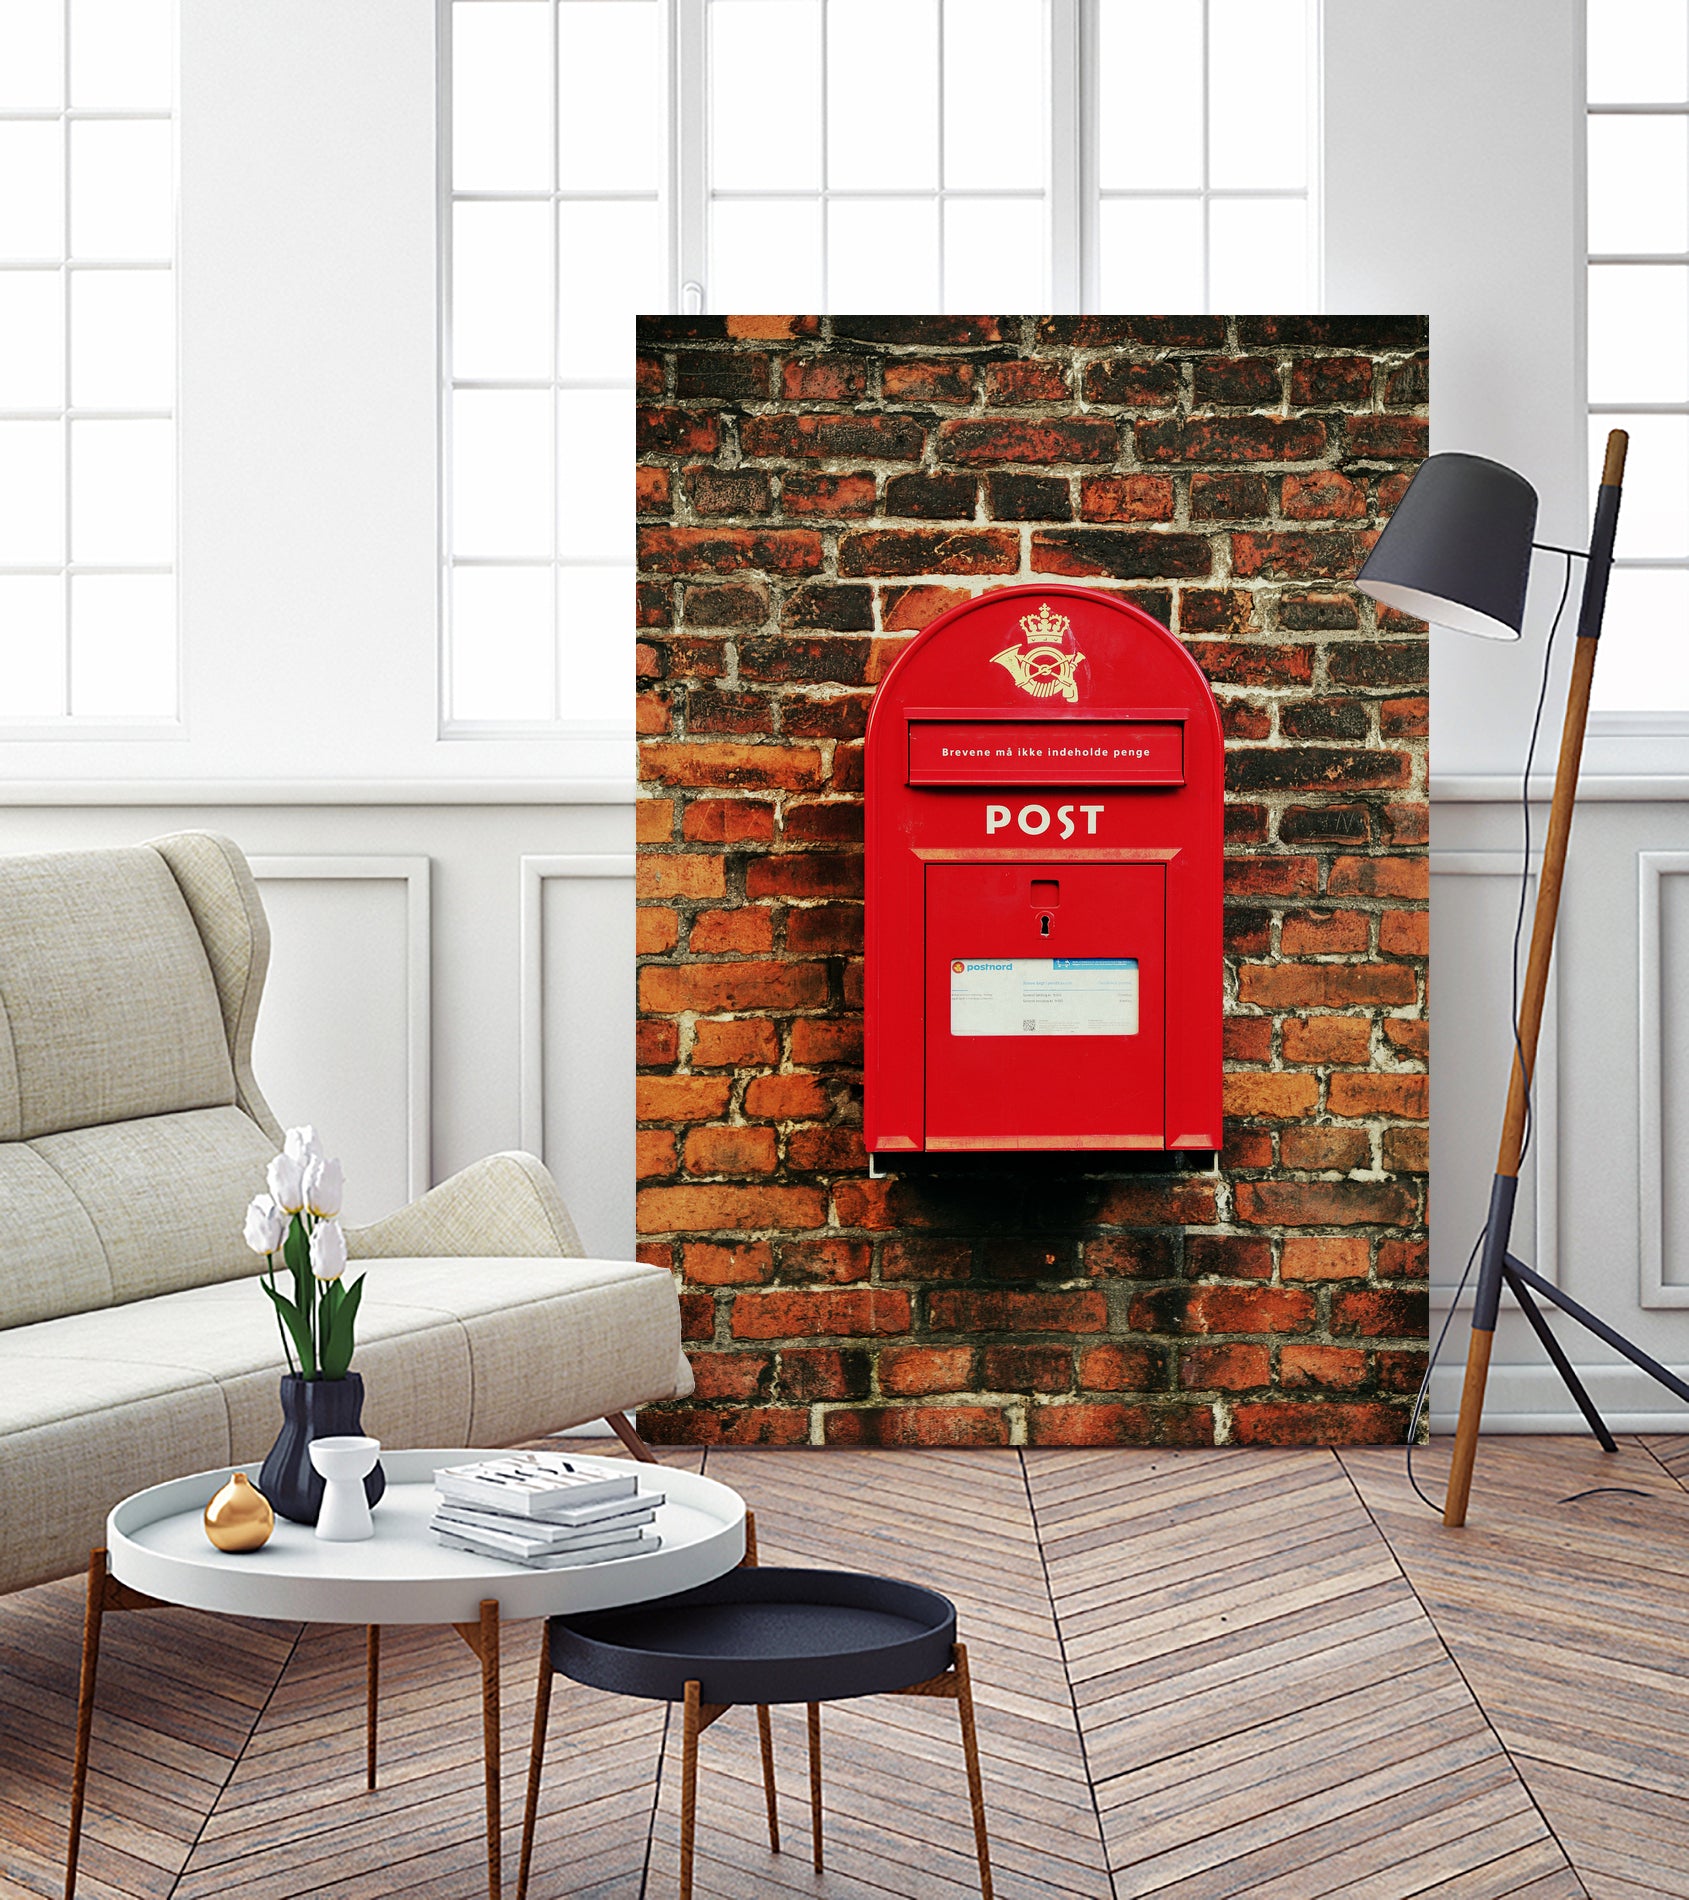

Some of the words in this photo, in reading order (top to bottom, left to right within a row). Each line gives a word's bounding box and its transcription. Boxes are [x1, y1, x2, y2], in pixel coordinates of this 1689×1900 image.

[942, 747, 991, 757] Brevene
[995, 747, 1013, 757] må
[1017, 747, 1043, 757] ikke
[1047, 747, 1109, 757] indeholde
[1113, 749, 1150, 759] penge
[986, 804, 1105, 841] POST
[966, 962, 1013, 973] postnord
